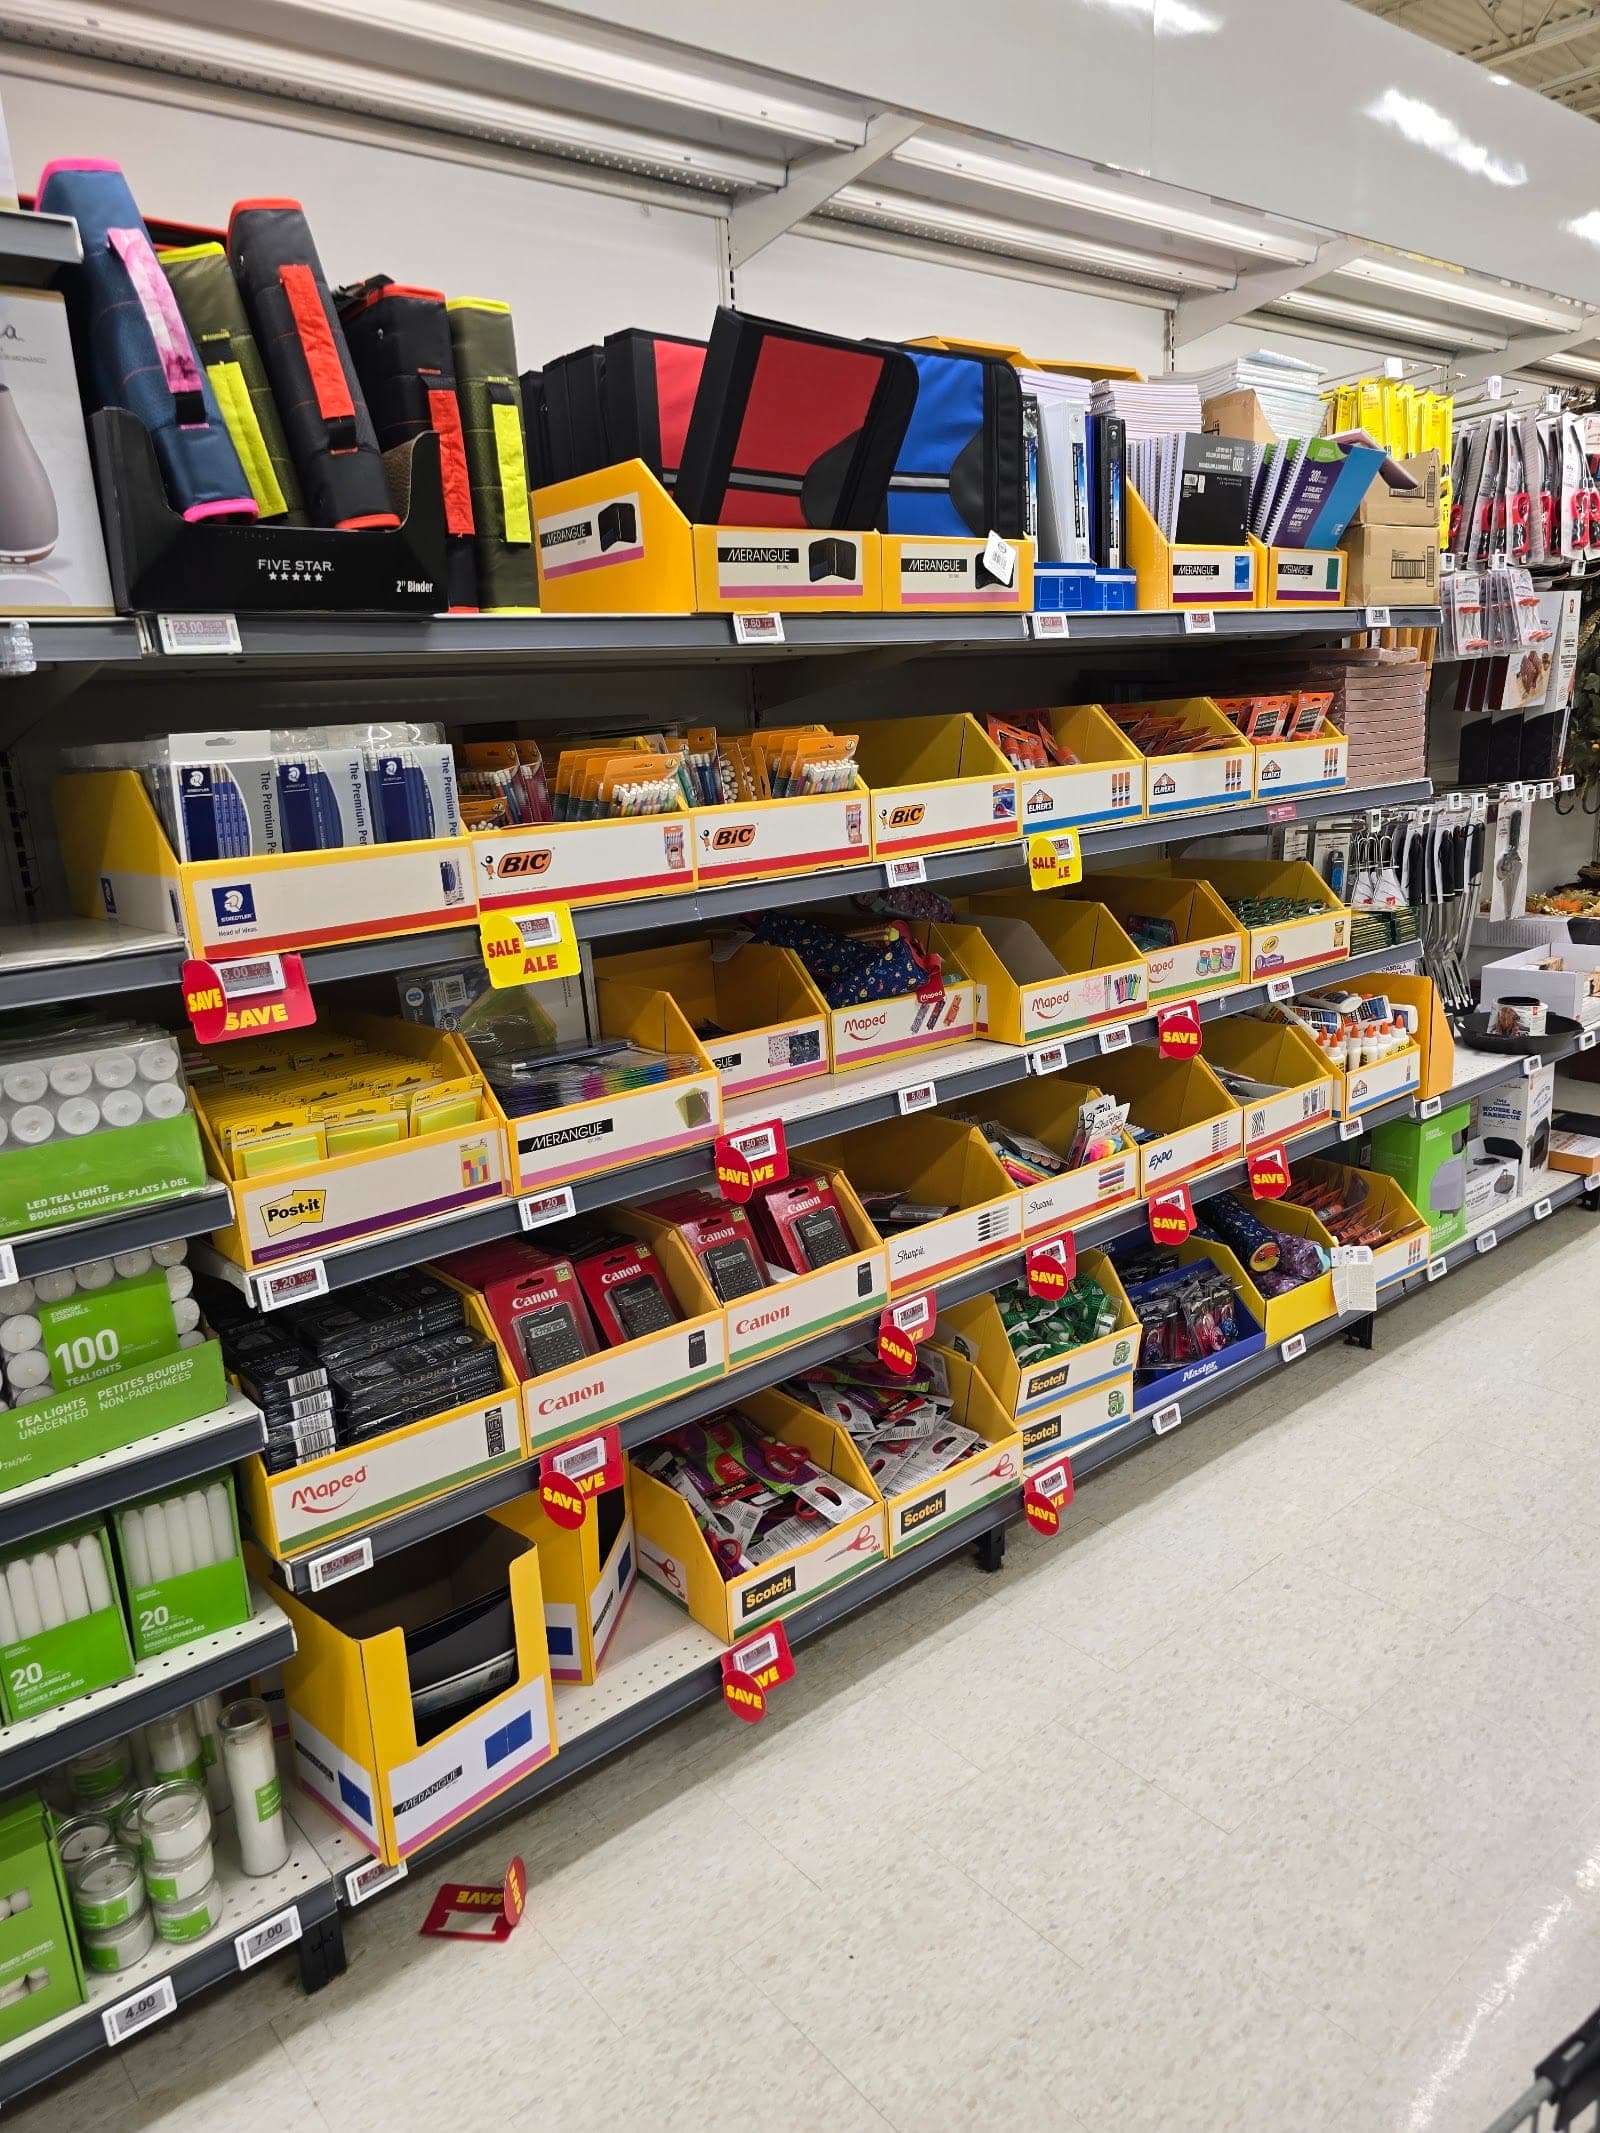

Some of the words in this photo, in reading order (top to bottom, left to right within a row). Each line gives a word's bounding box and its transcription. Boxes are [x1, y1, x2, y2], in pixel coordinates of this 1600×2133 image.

[546, 524, 586, 546] MERANGUE
[258, 559, 291, 572] FIVE
[727, 549, 790, 562] MERANGUE
[908, 559, 961, 571] MERANGUE
[1178, 565, 1215, 575] MERANGUE
[396, 581, 406, 593] 2"
[407, 580, 433, 593] Binder
[173, 621, 204, 634] 23.00
[349, 761, 360, 780] The
[441, 755, 450, 772] The
[260, 771, 270, 791] The
[350, 782, 367, 828] Premium
[442, 774, 456, 821] Premium
[1027, 801, 1054, 813] ELMER'S
[262, 793, 275, 840] Premium
[1032, 857, 1056, 870] SALE
[1058, 866, 1071, 879] LE
[487, 938, 521, 958] SALE
[223, 967, 248, 981] 3.00
[523, 954, 558, 974] ALE
[1149, 959, 1174, 975] aped
[187, 988, 223, 1013] SAVE
[920, 990, 942, 1001] Maped
[1032, 992, 1069, 1012] Maped
[225, 1003, 288, 1031] SAVE
[844, 1012, 886, 1033] Maped
[1162, 1031, 1198, 1045] SAVE
[531, 1122, 603, 1150] MERANGUE
[1148, 1149, 1173, 1170] EXPO
[718, 1165, 750, 1187] SAVE
[1253, 1174, 1286, 1184] SAVE
[27, 1198, 48, 1210] LED
[51, 1193, 70, 1205] TEA
[72, 1184, 110, 1199] LIGHTS
[29, 1205, 76, 1222] BOUGIES
[76, 1183, 159, 1210] CHAUFFE-PLATS
[161, 1179, 168, 1190] À
[169, 1177, 190, 1188] DEL
[538, 1197, 558, 1212] 1.20
[787, 1195, 821, 1214] Canon
[267, 1197, 320, 1223] Post-it
[1153, 1217, 1187, 1231] SAVE
[697, 1226, 736, 1245] Canon
[895, 1245, 925, 1265] Sharpie
[601, 1263, 642, 1284] Canon
[1030, 1270, 1065, 1287] SAVE
[271, 1277, 296, 1293] 5.20
[512, 1287, 558, 1310] Canon
[736, 1305, 790, 1336] Canon
[908, 1327, 924, 1342] VE
[55, 1328, 120, 1375] 100
[881, 1336, 912, 1365] SAVE
[66, 1362, 122, 1387] TEALIGHTS
[97, 1376, 145, 1400] PETITES
[146, 1358, 194, 1382] BOUGIES
[1030, 1373, 1066, 1393] Scotch
[99, 1371, 192, 1411] NON-PARFUMÉES
[539, 1380, 605, 1416] Canon
[16, 1414, 42, 1430] TEA
[43, 1397, 87, 1421] LIGHTS
[19, 1407, 89, 1440] UNSCENTED
[1023, 1421, 1059, 1445] Scotch
[291, 1465, 368, 1509] Maped
[543, 1487, 582, 1515] SAVE
[1051, 1493, 1065, 1508] VE
[903, 1497, 943, 1527] Scotch
[1027, 1504, 1057, 1525] SAVE
[746, 1575, 792, 1609] Scotch
[139, 1606, 169, 1632] 20
[10, 1662, 43, 1691] 20
[726, 1684, 763, 1710] SAVE
[400, 1770, 458, 1813] MERANGUE
[456, 1891, 504, 1905] SAVE
[254, 1920, 284, 1946] 7.00
[125, 1995, 156, 2020] 4.00
